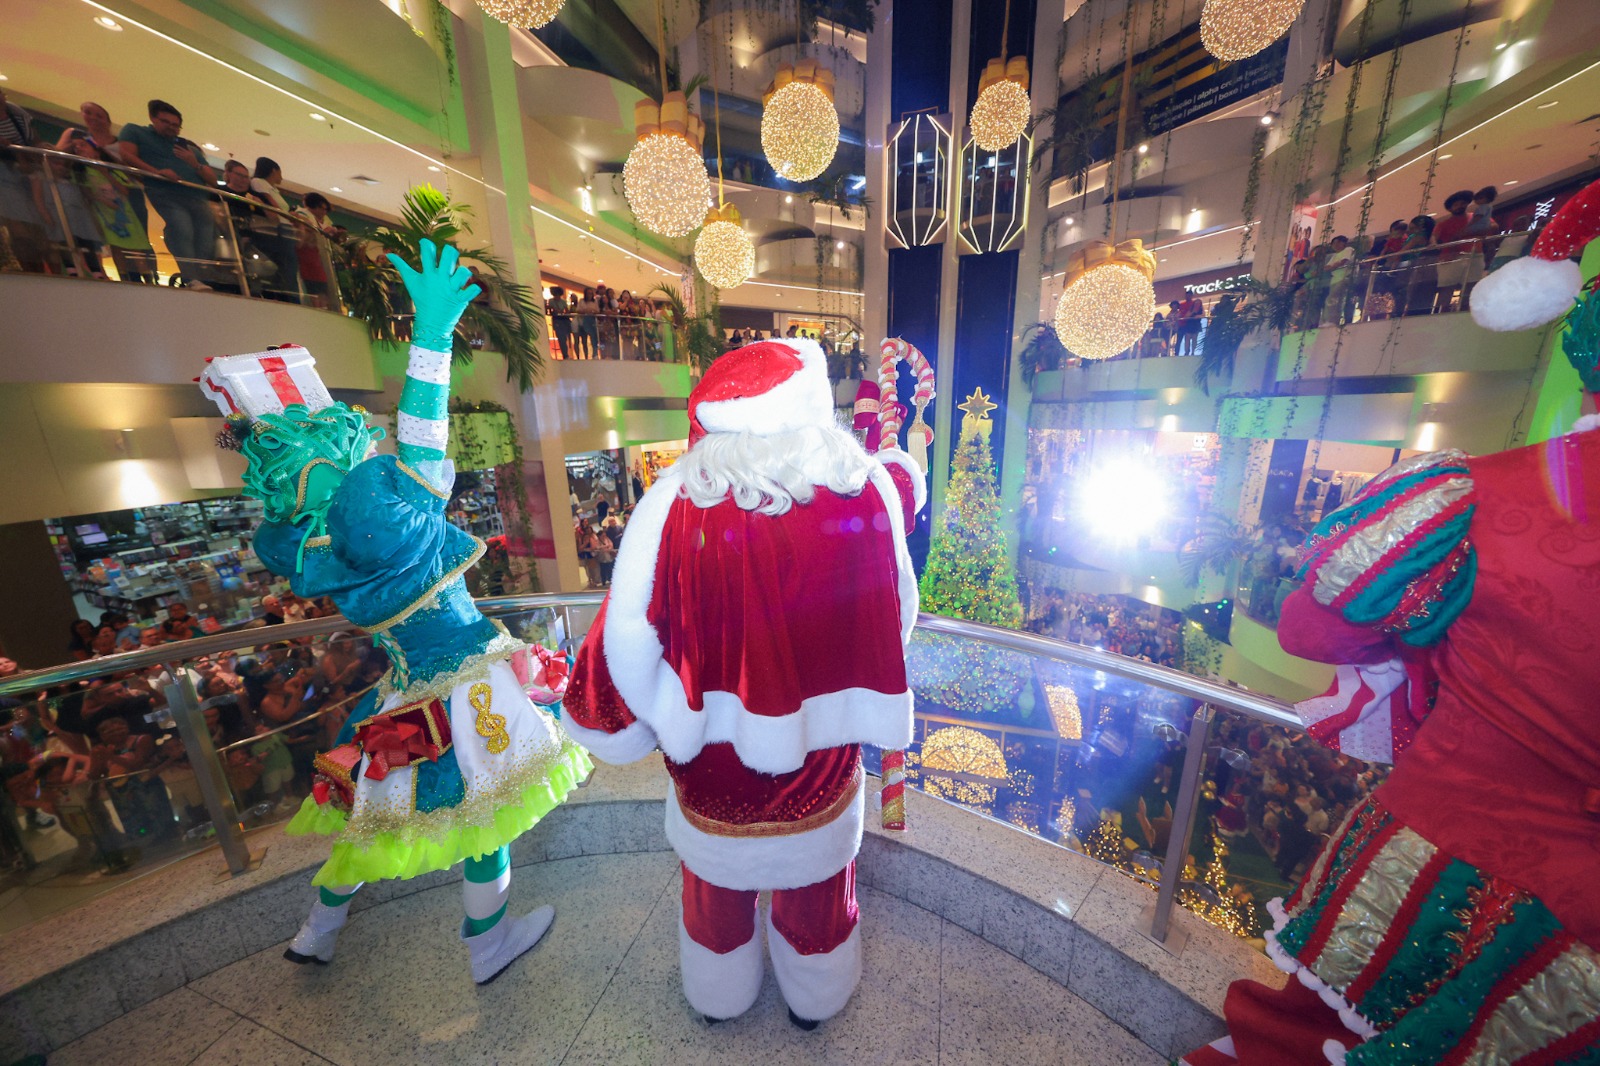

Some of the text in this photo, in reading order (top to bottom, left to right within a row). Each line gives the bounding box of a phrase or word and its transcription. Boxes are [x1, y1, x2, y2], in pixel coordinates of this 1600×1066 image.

[1197, 86, 1219, 100] alpha
[1218, 87, 1239, 101] boxe
[1184, 273, 1251, 294] Track&
